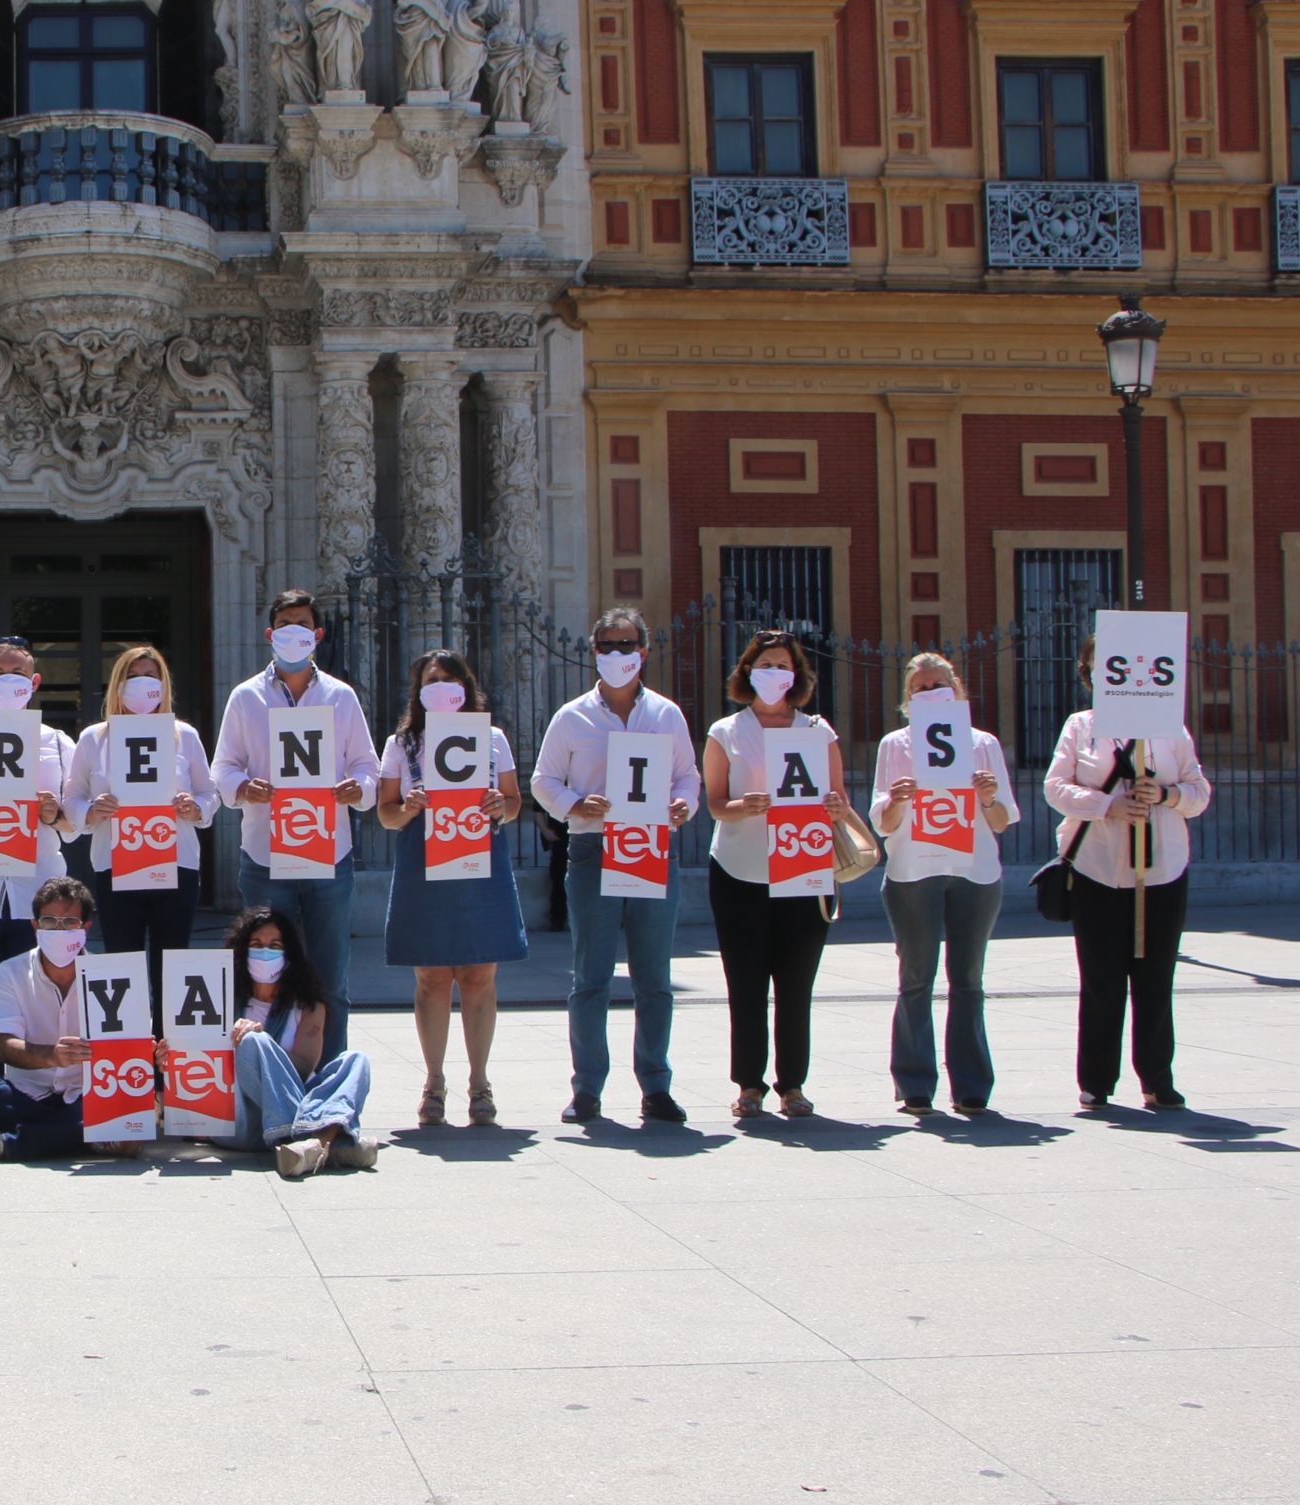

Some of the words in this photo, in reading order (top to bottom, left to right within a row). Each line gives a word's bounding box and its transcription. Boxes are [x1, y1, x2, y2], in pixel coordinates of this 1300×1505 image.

[1105, 690, 1174, 698] #SOSProfesReligión
[125, 737, 158, 783] E
[279, 730, 323, 778] N
[434, 735, 477, 783] C
[926, 723, 955, 768] S
[627, 757, 648, 803] I
[777, 753, 819, 798] A
